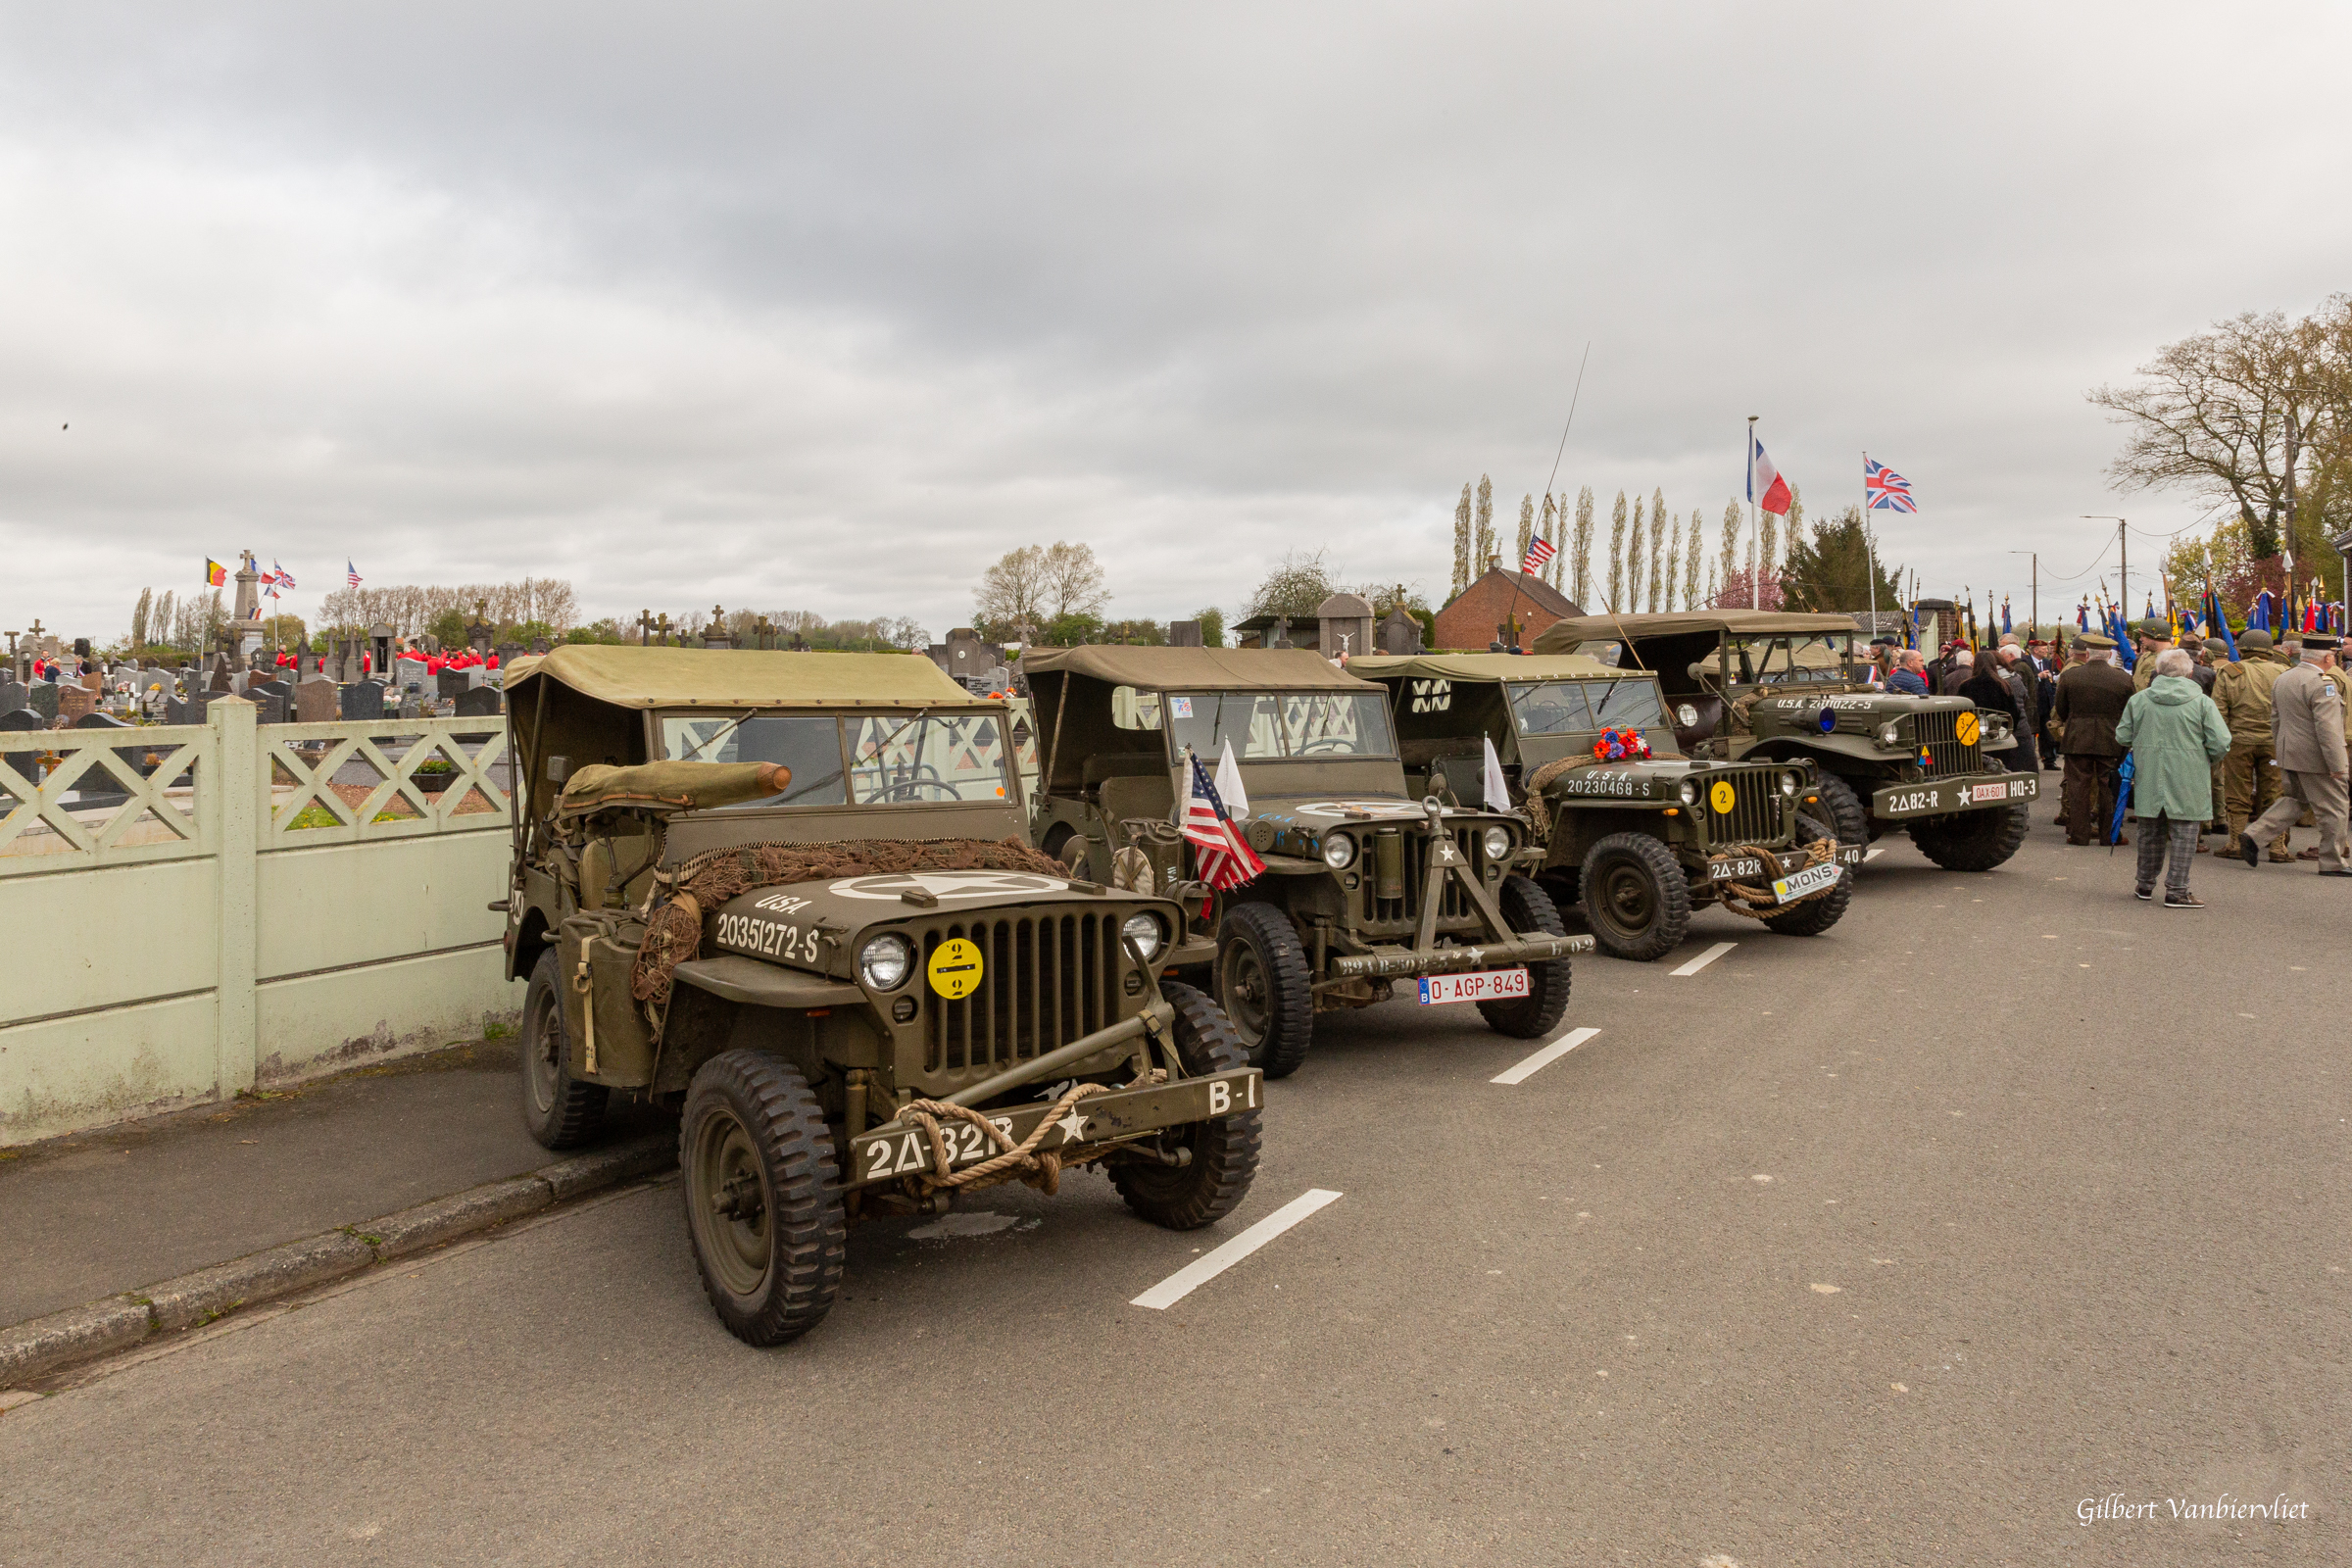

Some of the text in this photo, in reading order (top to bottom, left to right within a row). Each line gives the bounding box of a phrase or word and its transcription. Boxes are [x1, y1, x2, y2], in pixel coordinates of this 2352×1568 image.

[1778, 699, 1803, 710] U.S.A.
[1587, 770, 1632, 782] U.S.A.
[1719, 790, 1727, 804] 2
[1786, 865, 1833, 892] MONS
[755, 894, 812, 915] U.S.A.
[716, 912, 819, 963] 20351272-S
[952, 943, 962, 960] 2
[952, 979, 962, 997] 2
[1421, 993, 1429, 1003] B
